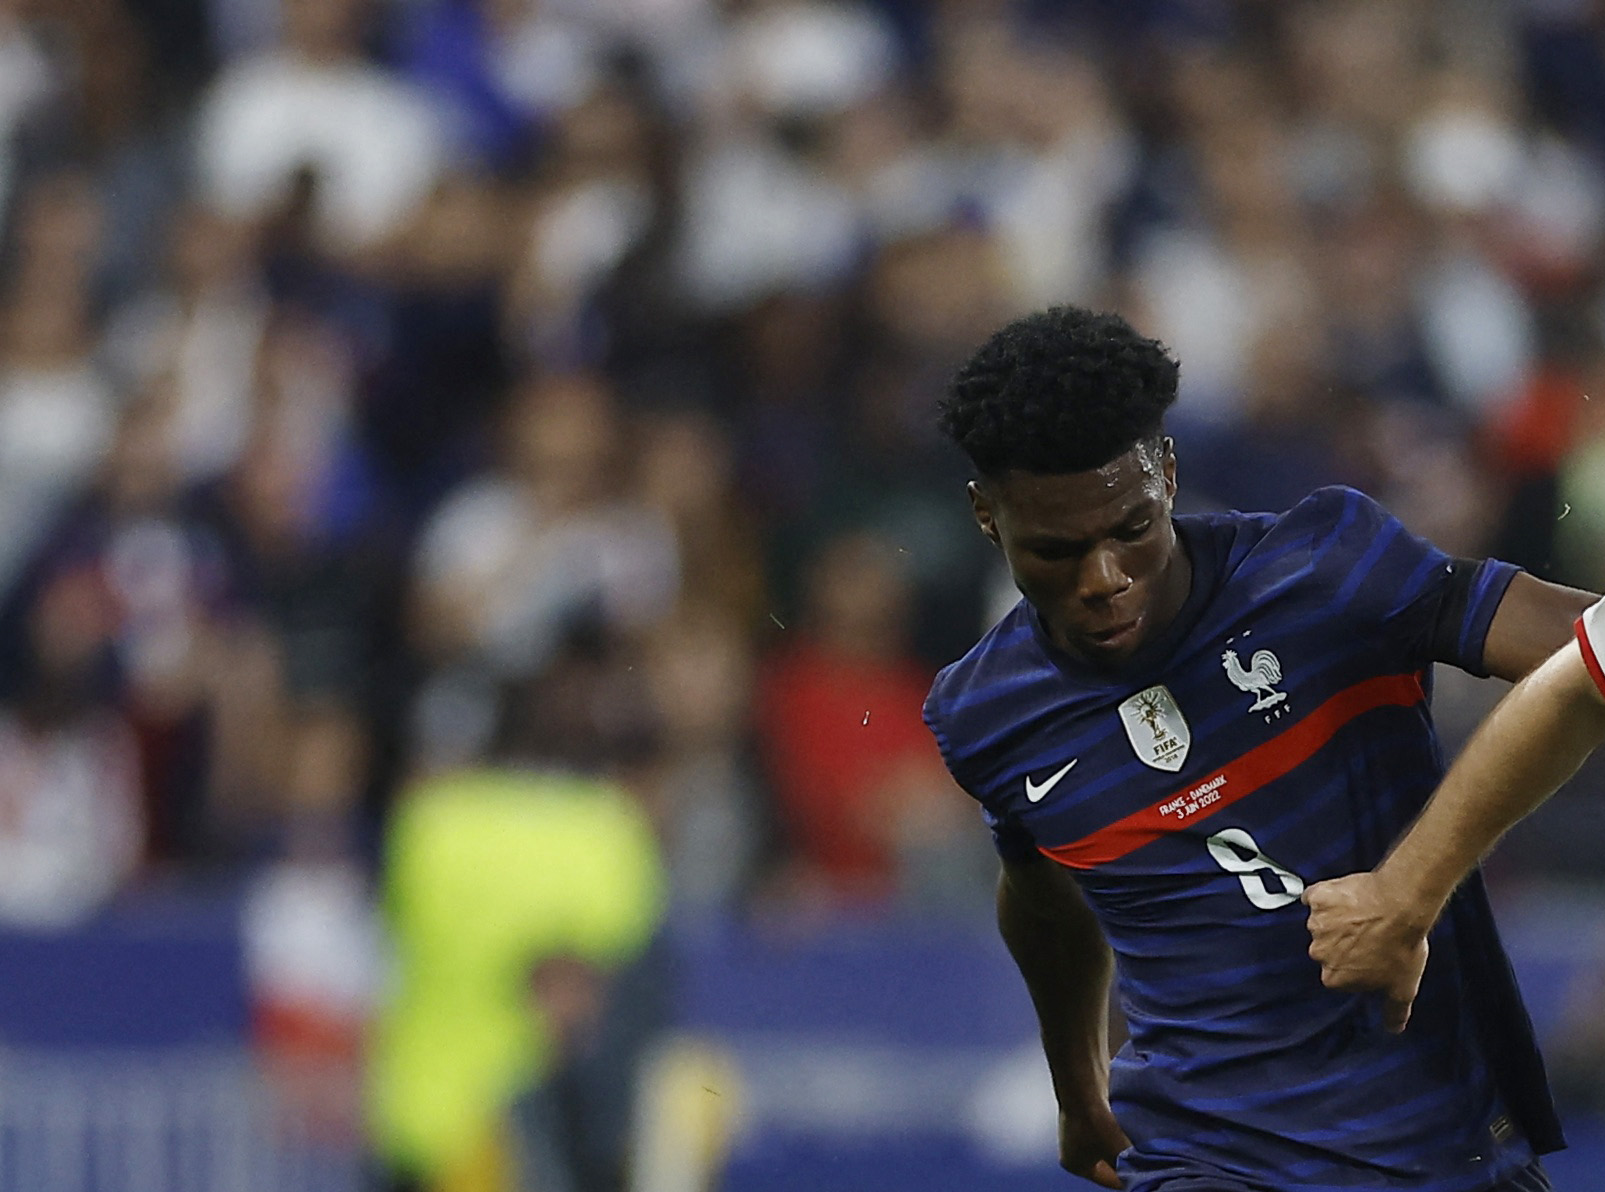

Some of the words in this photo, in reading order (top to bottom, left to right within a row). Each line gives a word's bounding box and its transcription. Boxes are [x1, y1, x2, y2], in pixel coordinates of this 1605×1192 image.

[1153, 739, 1178, 756] FIFA
[1159, 796, 1186, 816] FRANCE
[1176, 808, 1185, 820] 3
[1198, 789, 1222, 809] 2022
[1206, 828, 1304, 910] 8
